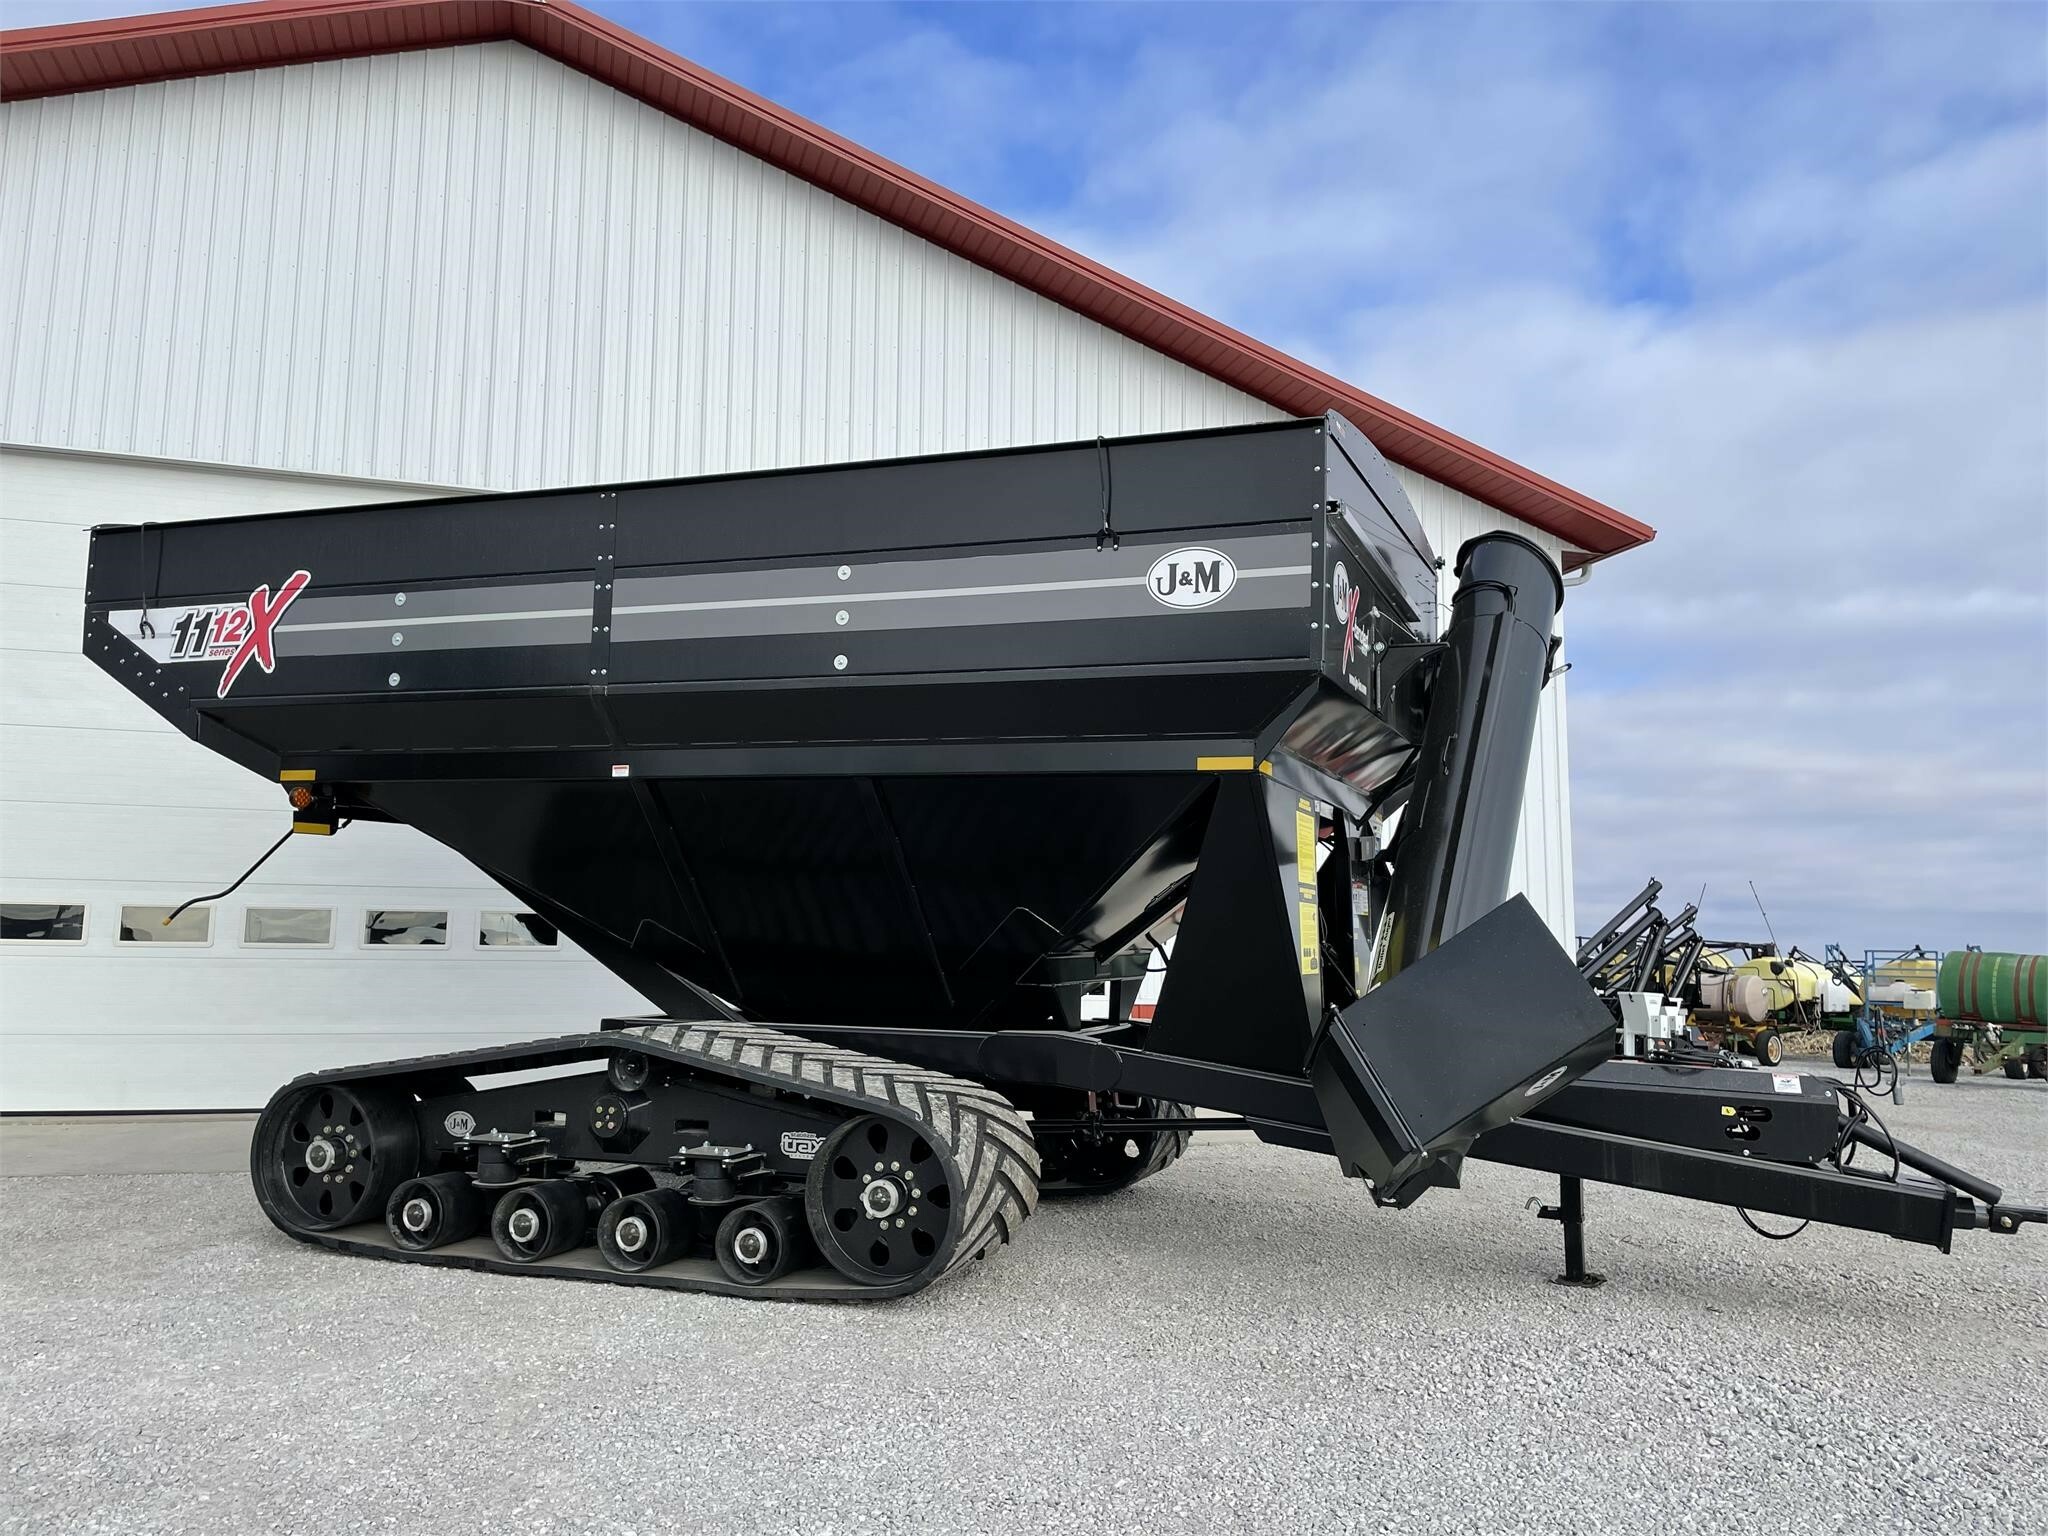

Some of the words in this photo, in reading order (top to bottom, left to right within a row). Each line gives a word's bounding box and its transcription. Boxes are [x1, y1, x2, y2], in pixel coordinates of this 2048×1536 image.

[1155, 560, 1222, 596] J&M
[208, 646, 236, 657] series
[450, 1117, 469, 1131] J&M
[783, 1136, 824, 1154] trax
